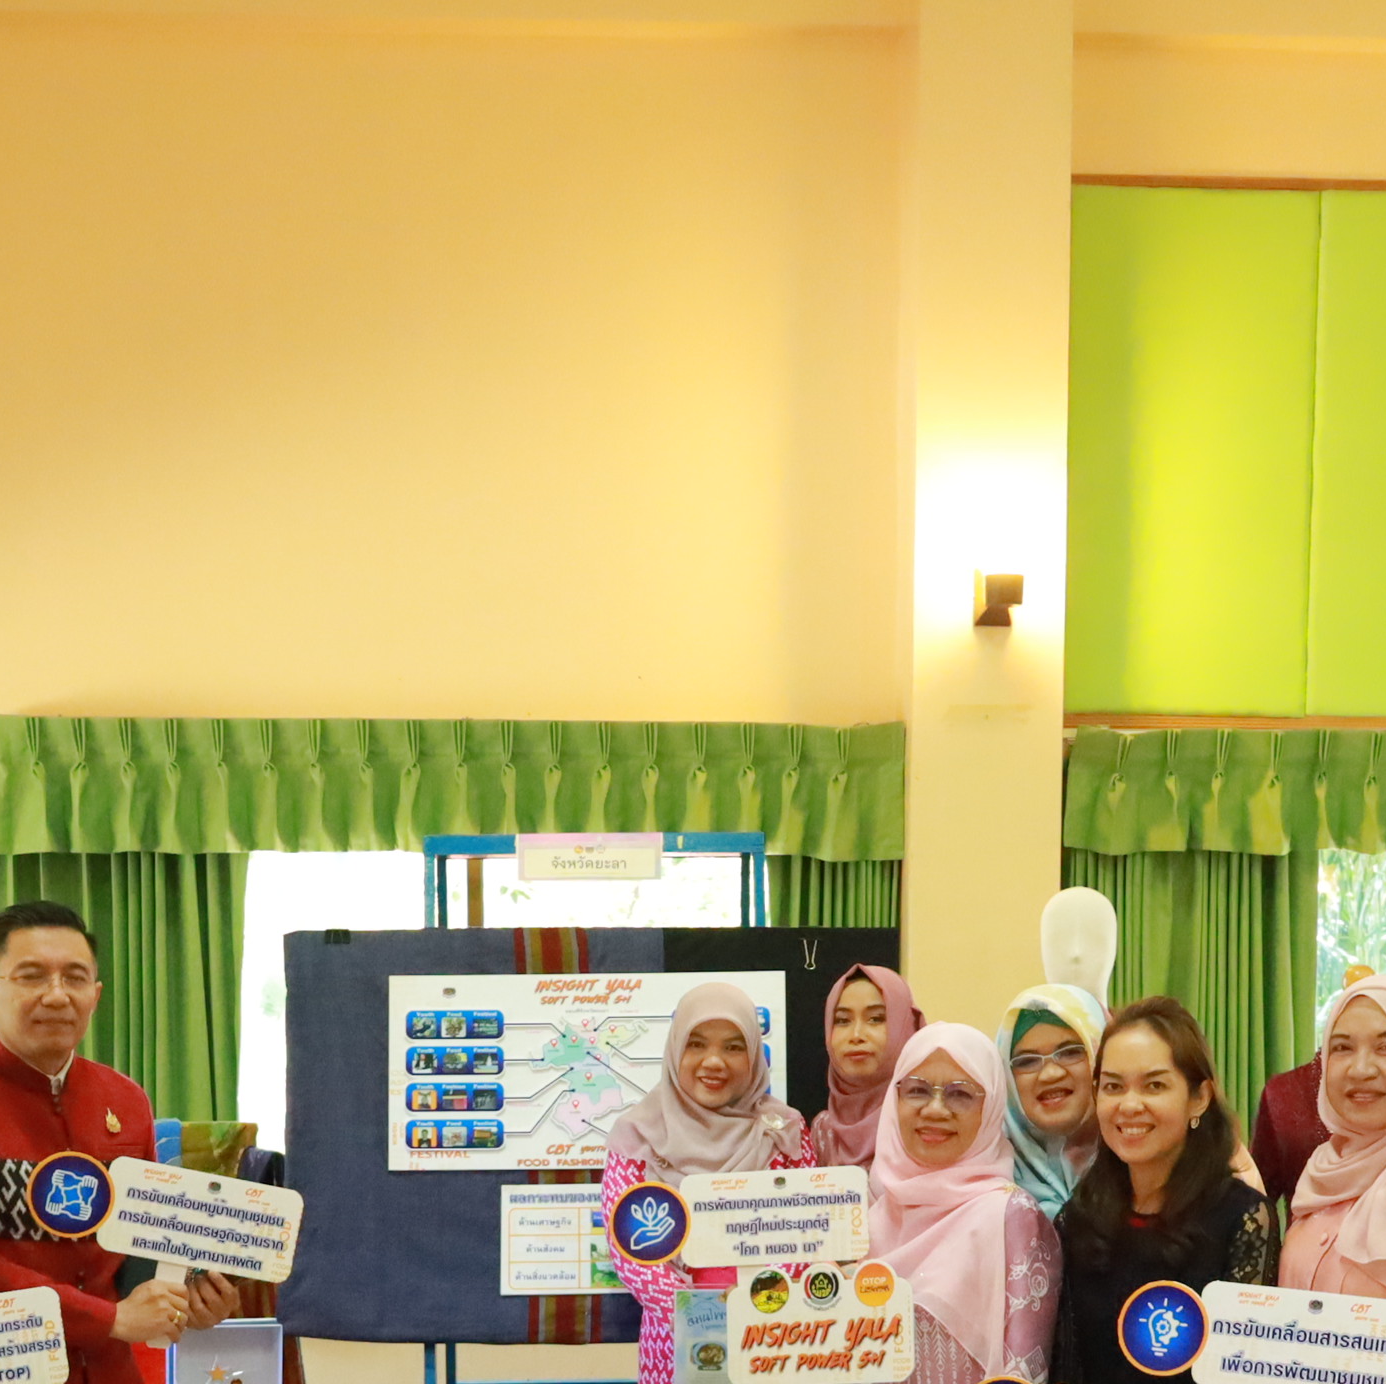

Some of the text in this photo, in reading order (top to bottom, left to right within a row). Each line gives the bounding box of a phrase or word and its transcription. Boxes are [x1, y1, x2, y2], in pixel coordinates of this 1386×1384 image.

[551, 856, 627, 870] จังหวัดยะลา
[535, 979, 643, 996] INSIGHT YALA
[540, 995, 569, 1005] SOFT
[572, 995, 610, 1005] POWER
[546, 1144, 572, 1155] CBT
[517, 1158, 604, 1167] FOOD FASHION
[810, 1173, 828, 1183] CBT
[245, 1188, 265, 1199] CBT
[694, 1190, 861, 1213] การพัฒนาคุณภาพชีวิตตามหลัก
[118, 1210, 284, 1251] การขับเคลื่อนเศรษฐกิจฐานราก
[132, 1236, 263, 1271] และแก้ไขปัญหายาเสพติด
[766, 1243, 797, 1255] หนอง
[862, 1277, 886, 1286] OTOP
[1350, 1303, 1372, 1314] CBT
[740, 1315, 902, 1350] INSIGHT YALA
[749, 1353, 792, 1374] SOFT
[795, 1351, 852, 1373] POWER
